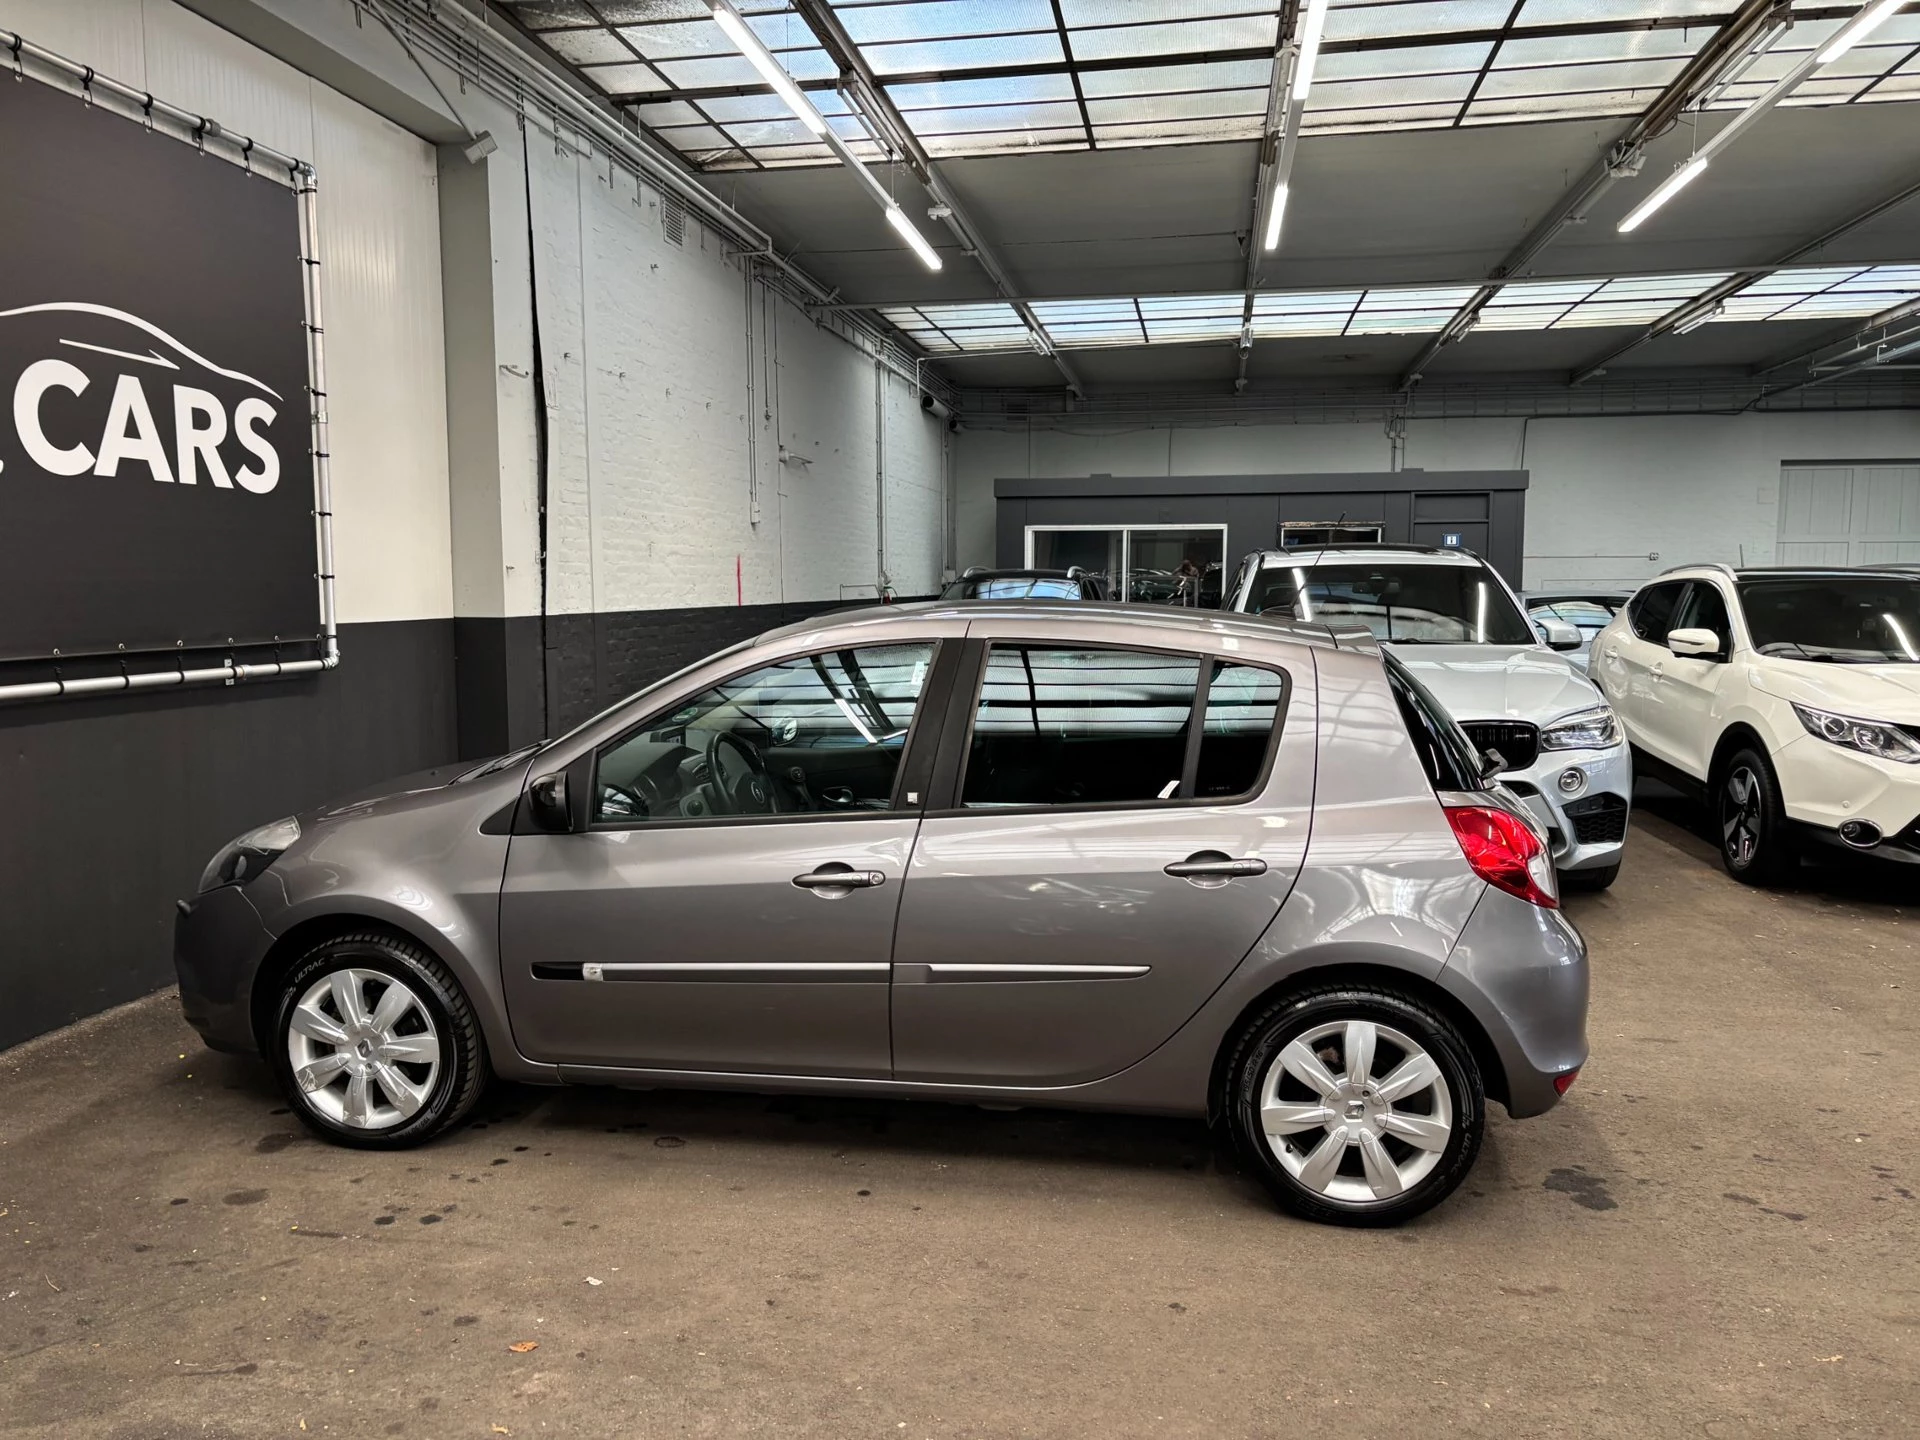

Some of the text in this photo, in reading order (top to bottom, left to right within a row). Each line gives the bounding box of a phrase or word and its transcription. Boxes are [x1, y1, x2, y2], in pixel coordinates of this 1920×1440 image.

[14, 359, 280, 494] CARS
[294, 957, 326, 984] ULTRAC
[1451, 1132, 1472, 1176] ULTRAC
